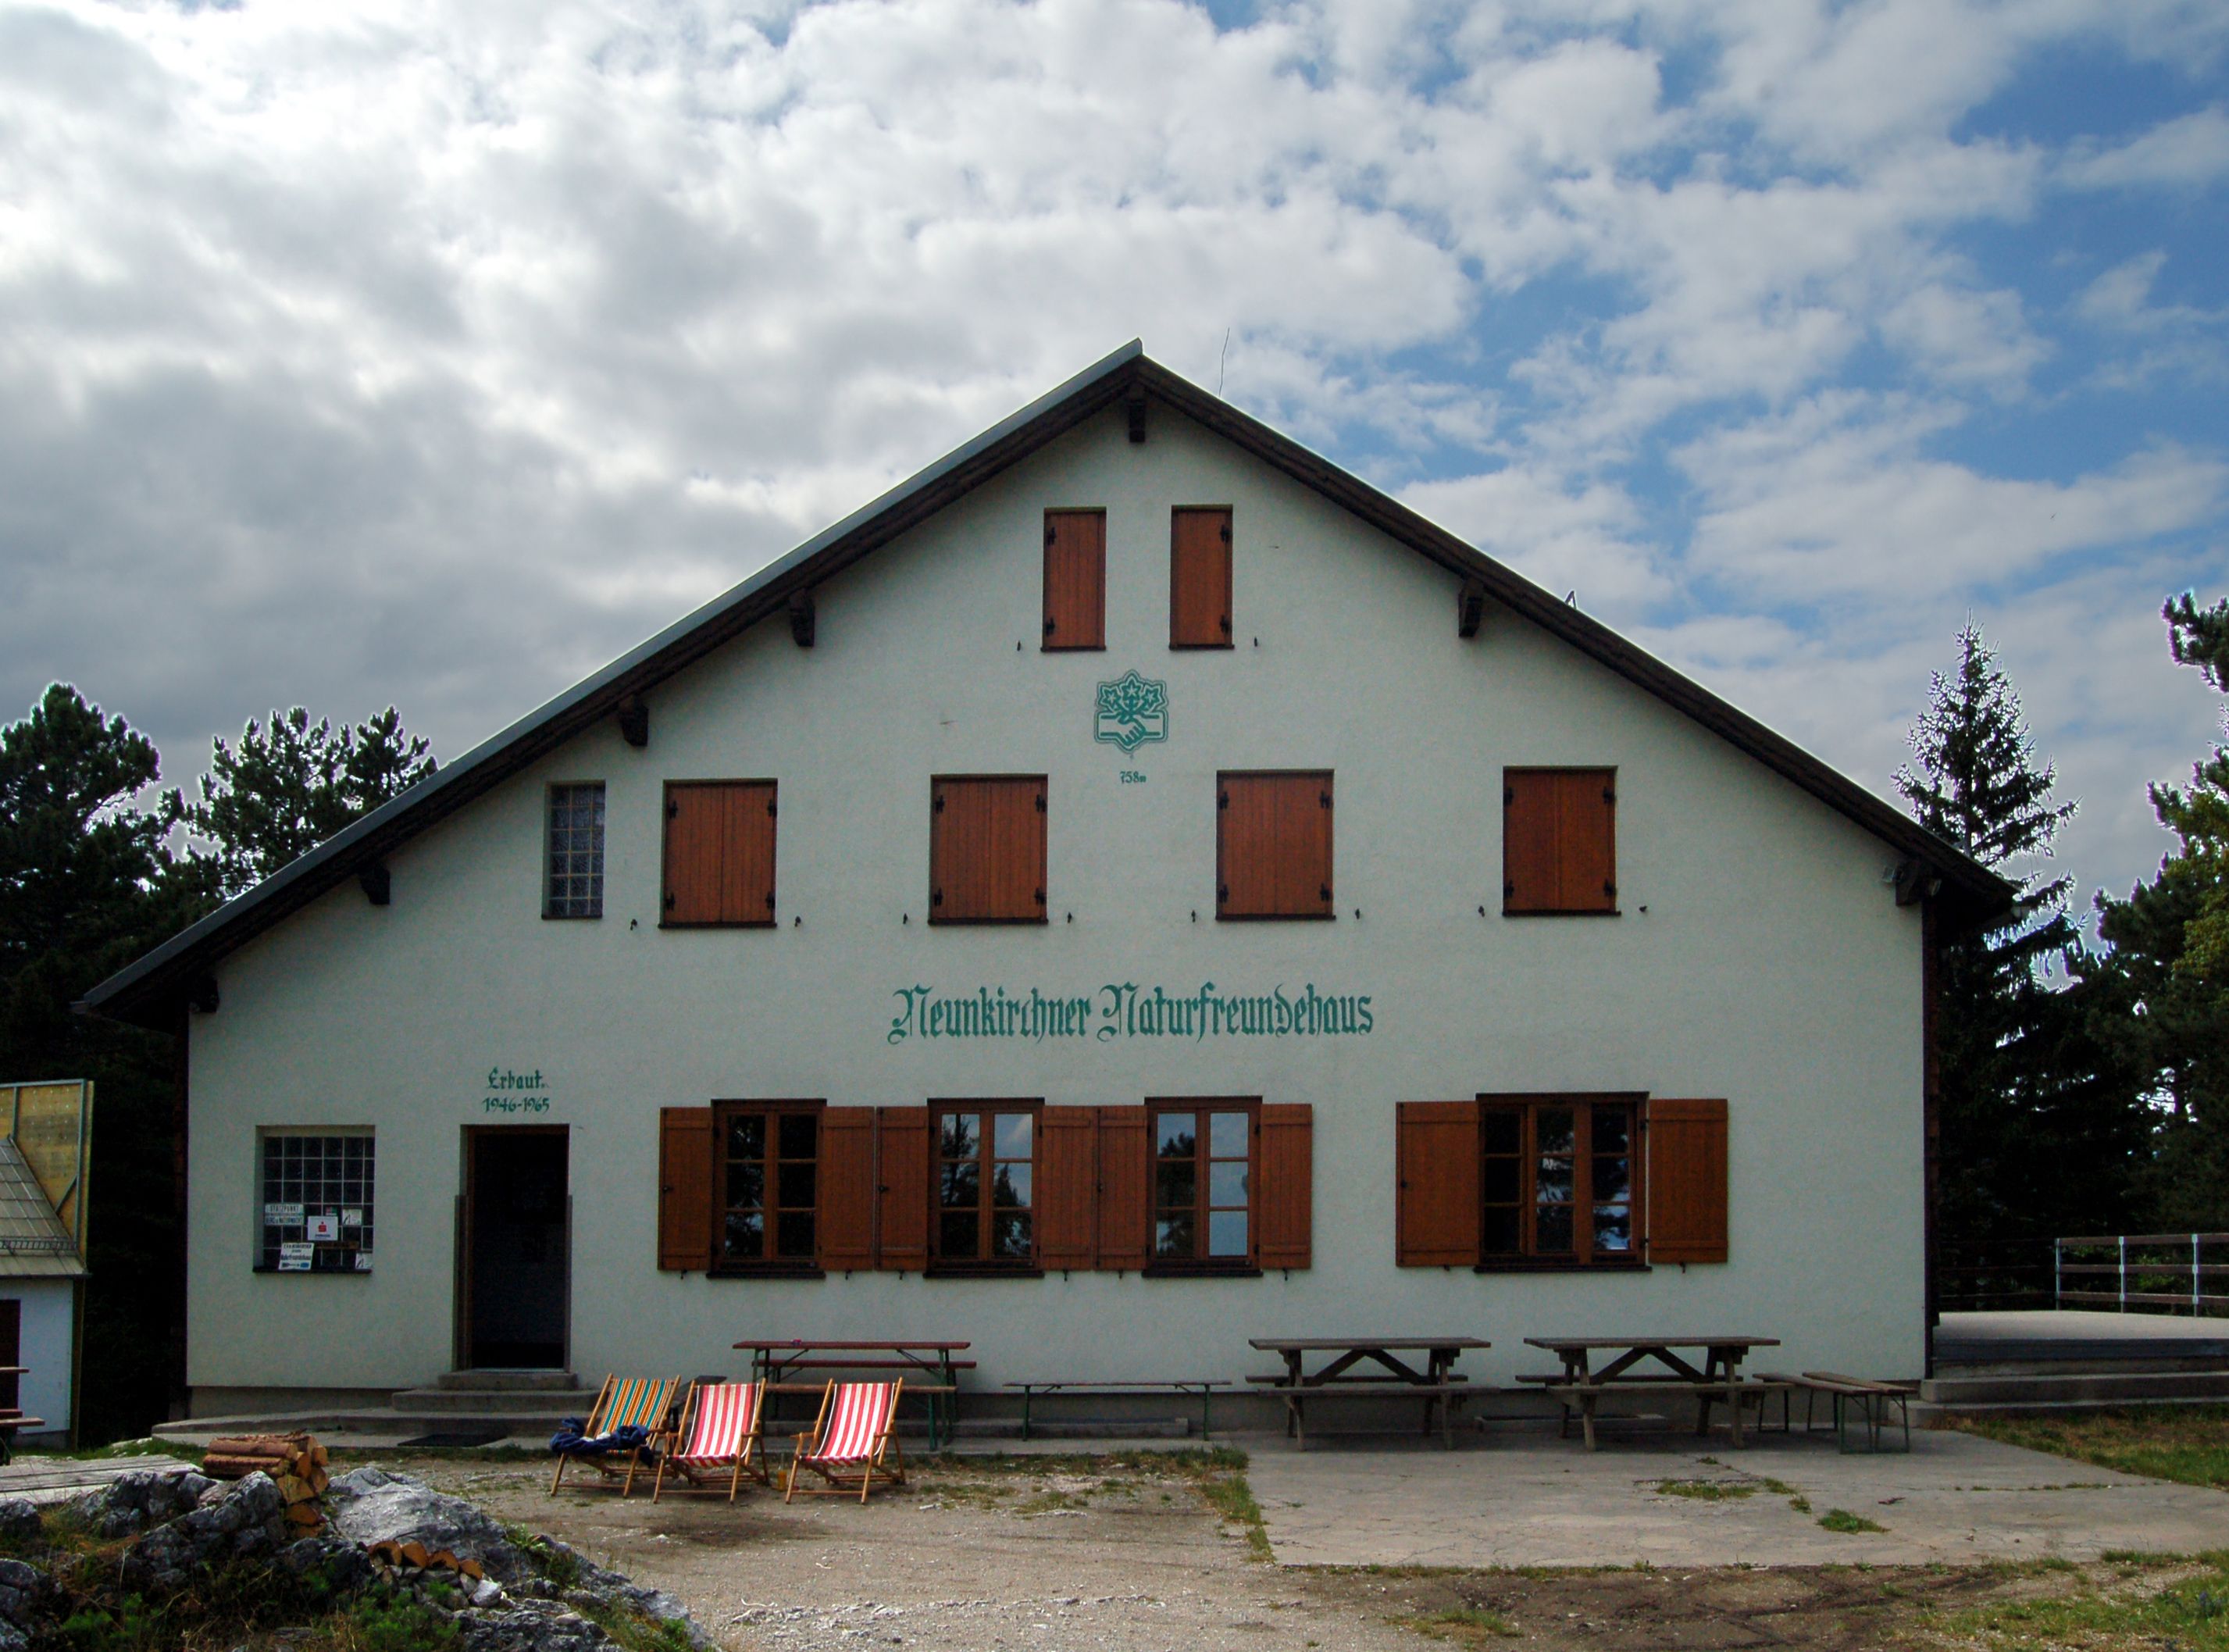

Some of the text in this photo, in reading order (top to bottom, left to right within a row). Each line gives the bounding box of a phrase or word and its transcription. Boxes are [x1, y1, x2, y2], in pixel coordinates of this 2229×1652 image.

[888, 981, 1374, 1045] Neunkirchner Naturfreundehaus
[482, 1097, 550, 1113] 1946-1965
